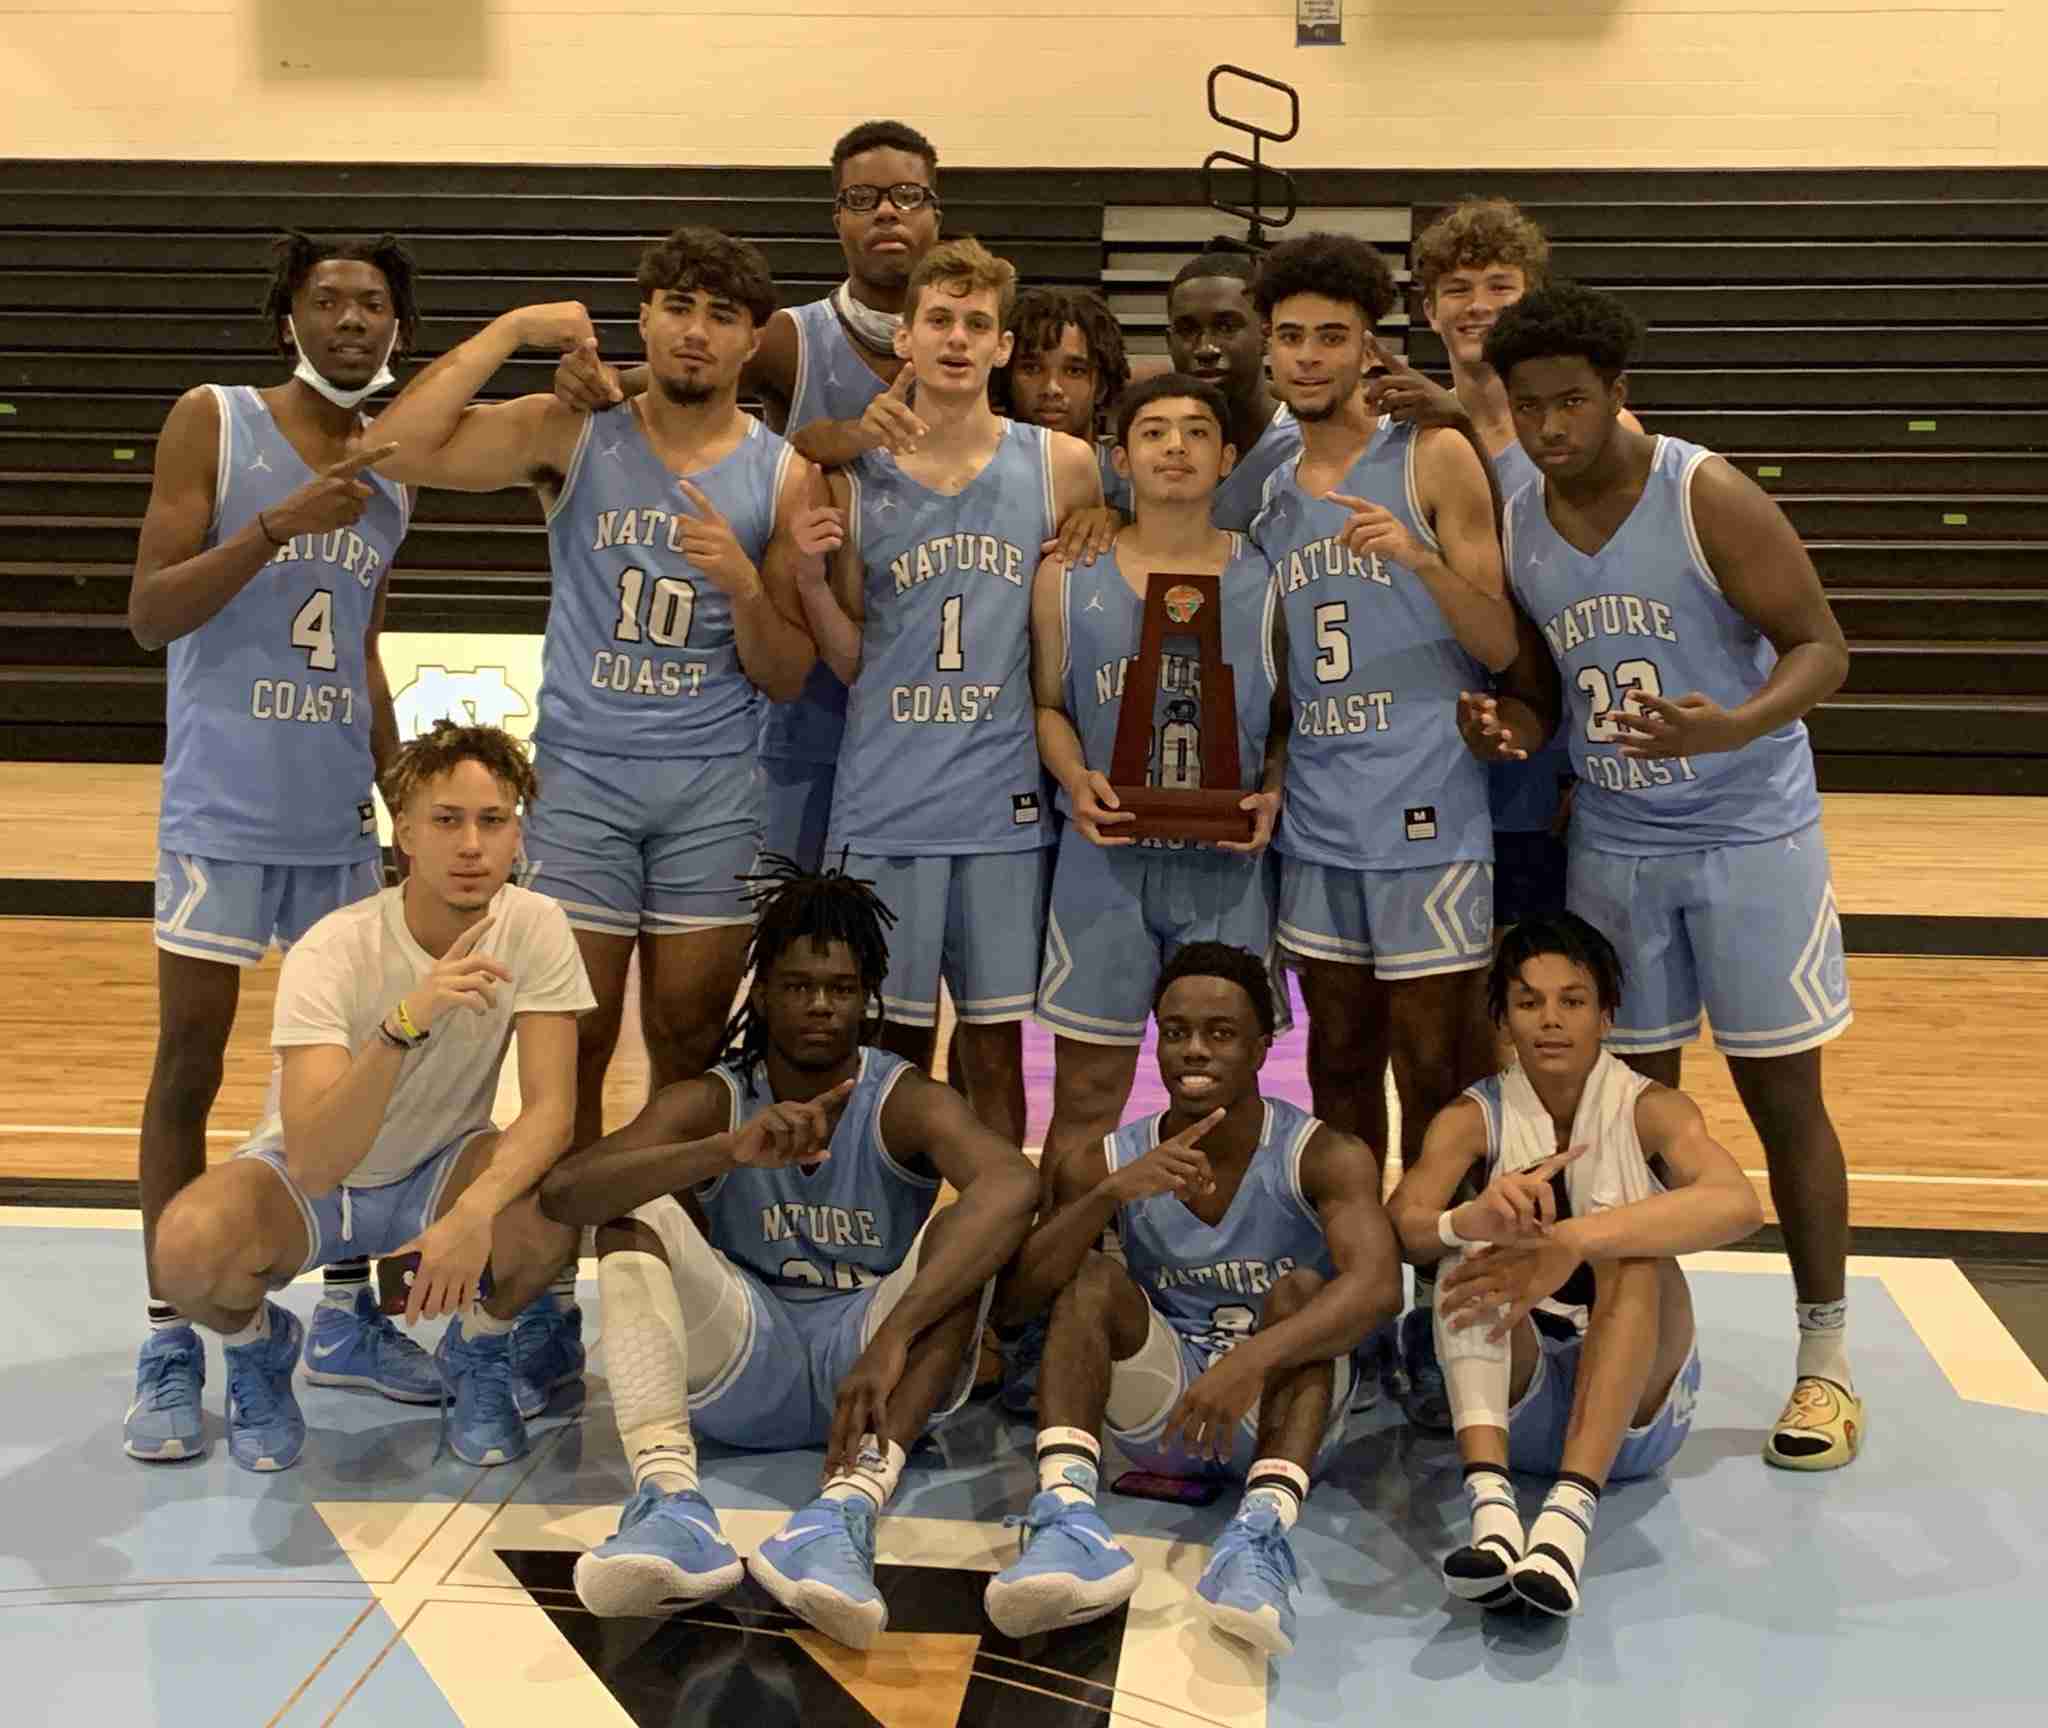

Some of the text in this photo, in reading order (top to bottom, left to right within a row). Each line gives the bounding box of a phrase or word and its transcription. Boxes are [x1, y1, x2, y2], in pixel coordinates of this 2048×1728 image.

[265, 528, 380, 588] ATURE
[890, 532, 1024, 594] NATURE
[290, 588, 337, 671] 4
[614, 565, 697, 648] 10
[936, 592, 964, 672] 1
[1544, 594, 1678, 659] NATURE
[1314, 600, 1353, 684] 5
[251, 678, 354, 725] COAST
[591, 650, 708, 697] COAST
[891, 685, 1001, 725] COAST
[761, 1201, 884, 1248] NTURE
